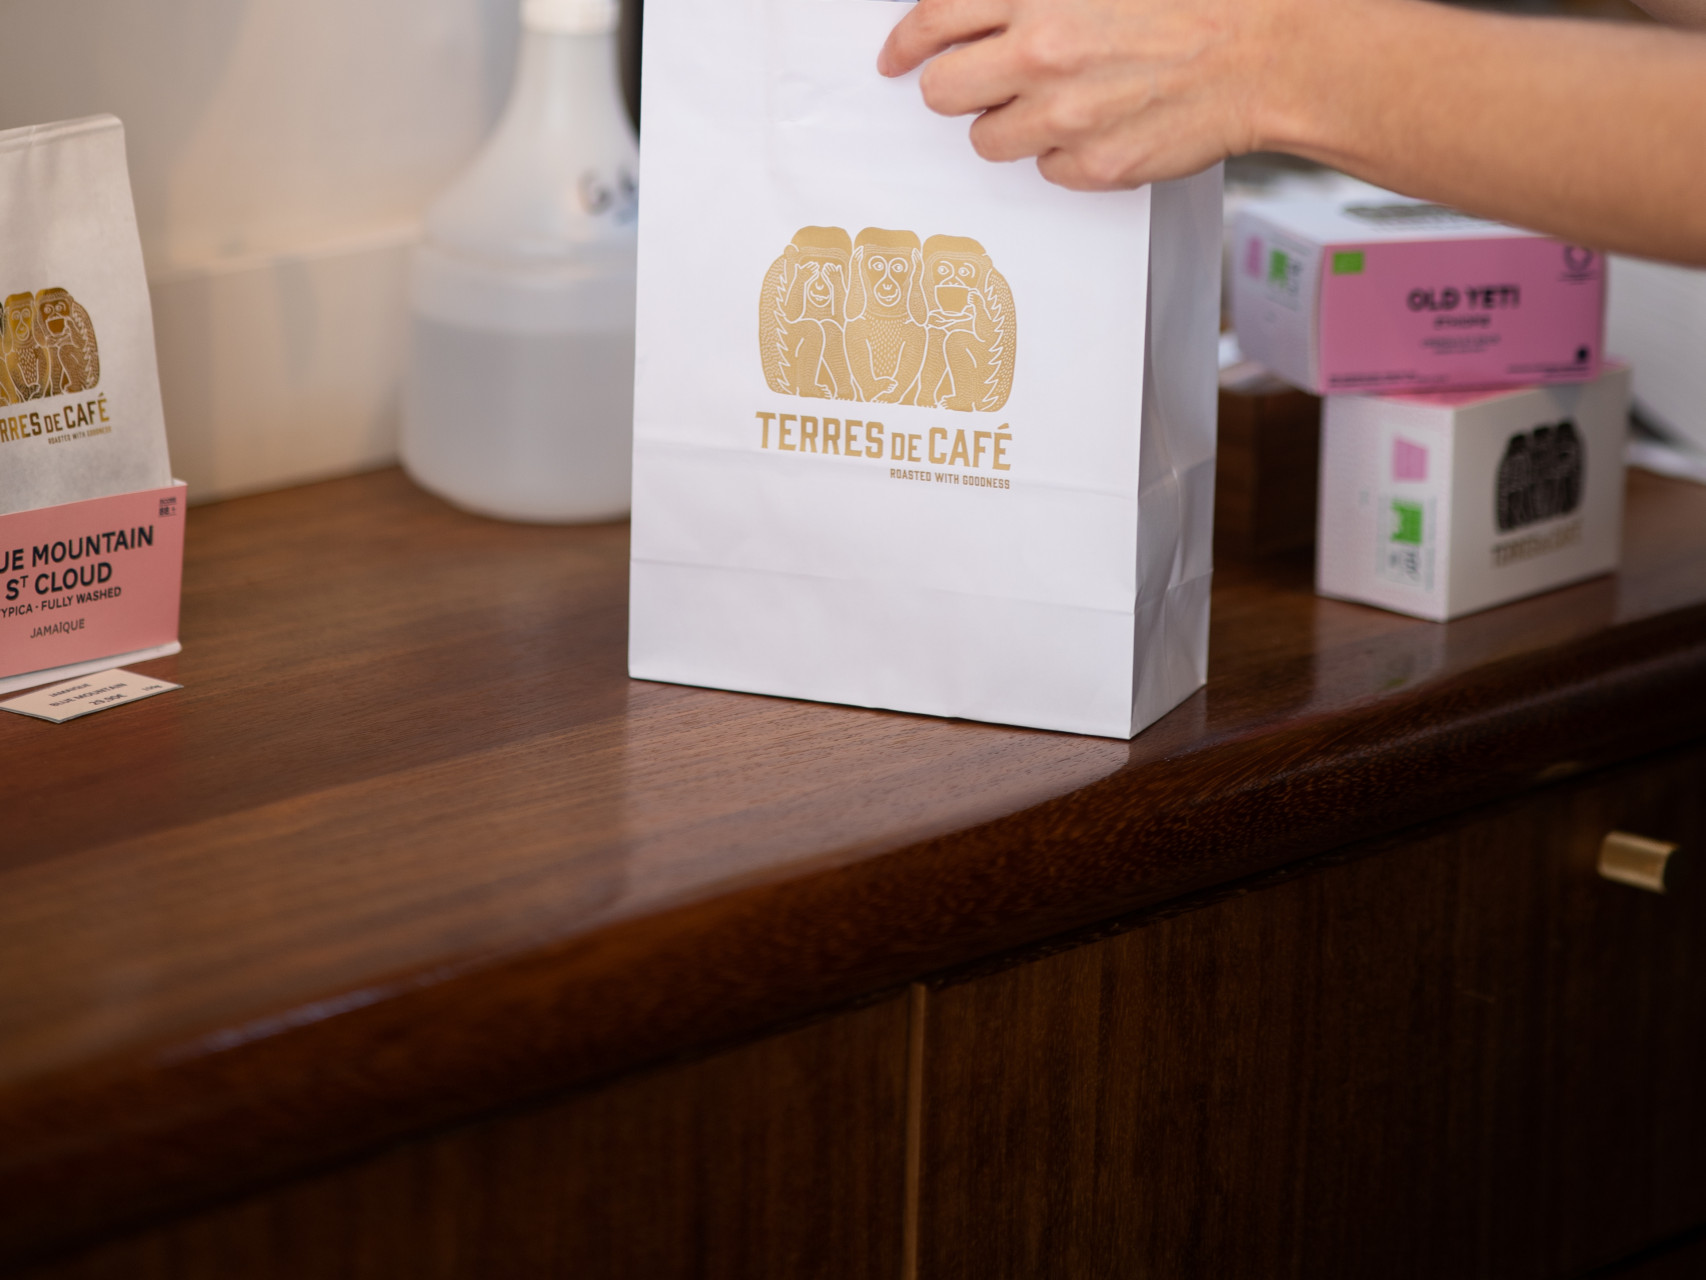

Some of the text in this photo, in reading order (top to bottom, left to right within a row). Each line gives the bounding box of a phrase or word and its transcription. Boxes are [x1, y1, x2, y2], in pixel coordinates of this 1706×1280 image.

[1407, 284, 1520, 312] OLD YETI
[44, 413, 63, 433] DE
[63, 392, 110, 429] CAFÉ
[755, 411, 1013, 471] TERRES DE CAFÉ
[890, 468, 1011, 490] ROASTED WITH GOODNESS
[32, 525, 154, 568] MOUNTAIN
[34, 562, 113, 595] CLOUD
[0, 603, 33, 619] YPICA
[41, 596, 74, 611] FULLY
[76, 586, 122, 604] WASHED
